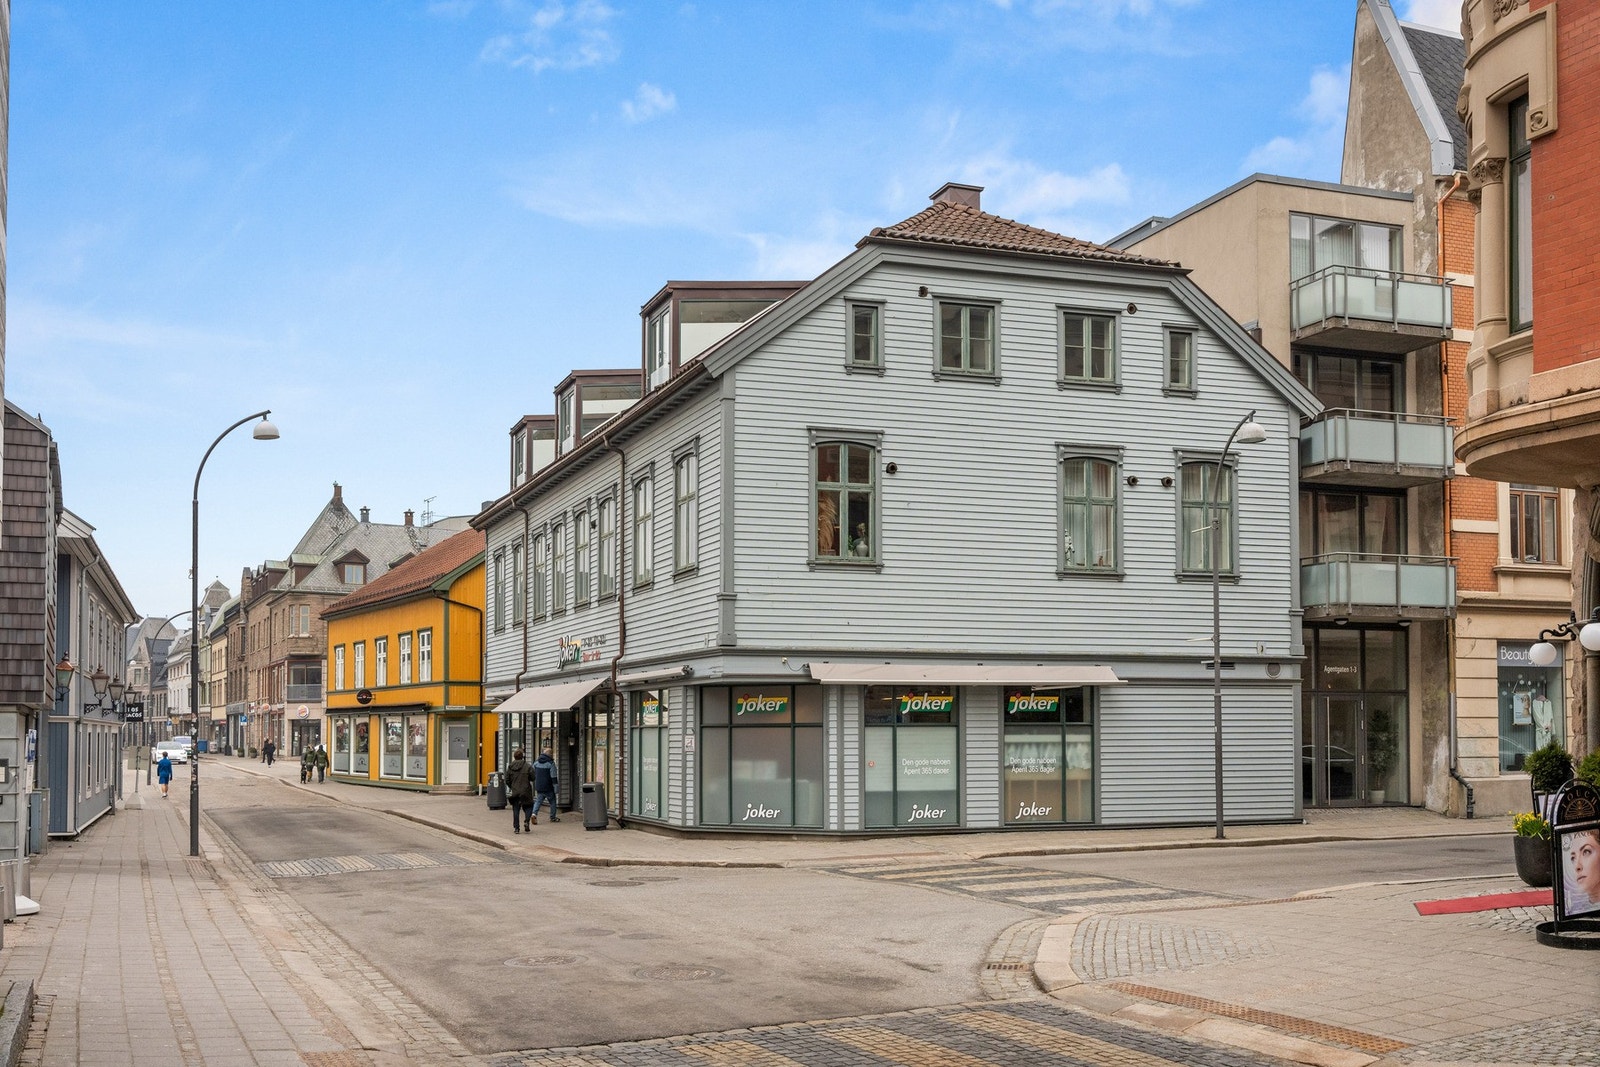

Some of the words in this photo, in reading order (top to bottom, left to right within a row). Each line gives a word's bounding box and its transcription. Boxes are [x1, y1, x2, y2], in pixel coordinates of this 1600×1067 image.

[737, 694, 784, 716] joker
[902, 692, 949, 714] joker
[1010, 692, 1055, 714] joker
[902, 758, 914, 766] Den
[742, 803, 781, 821] joker
[907, 804, 947, 822] joker
[1015, 801, 1052, 820] joker
